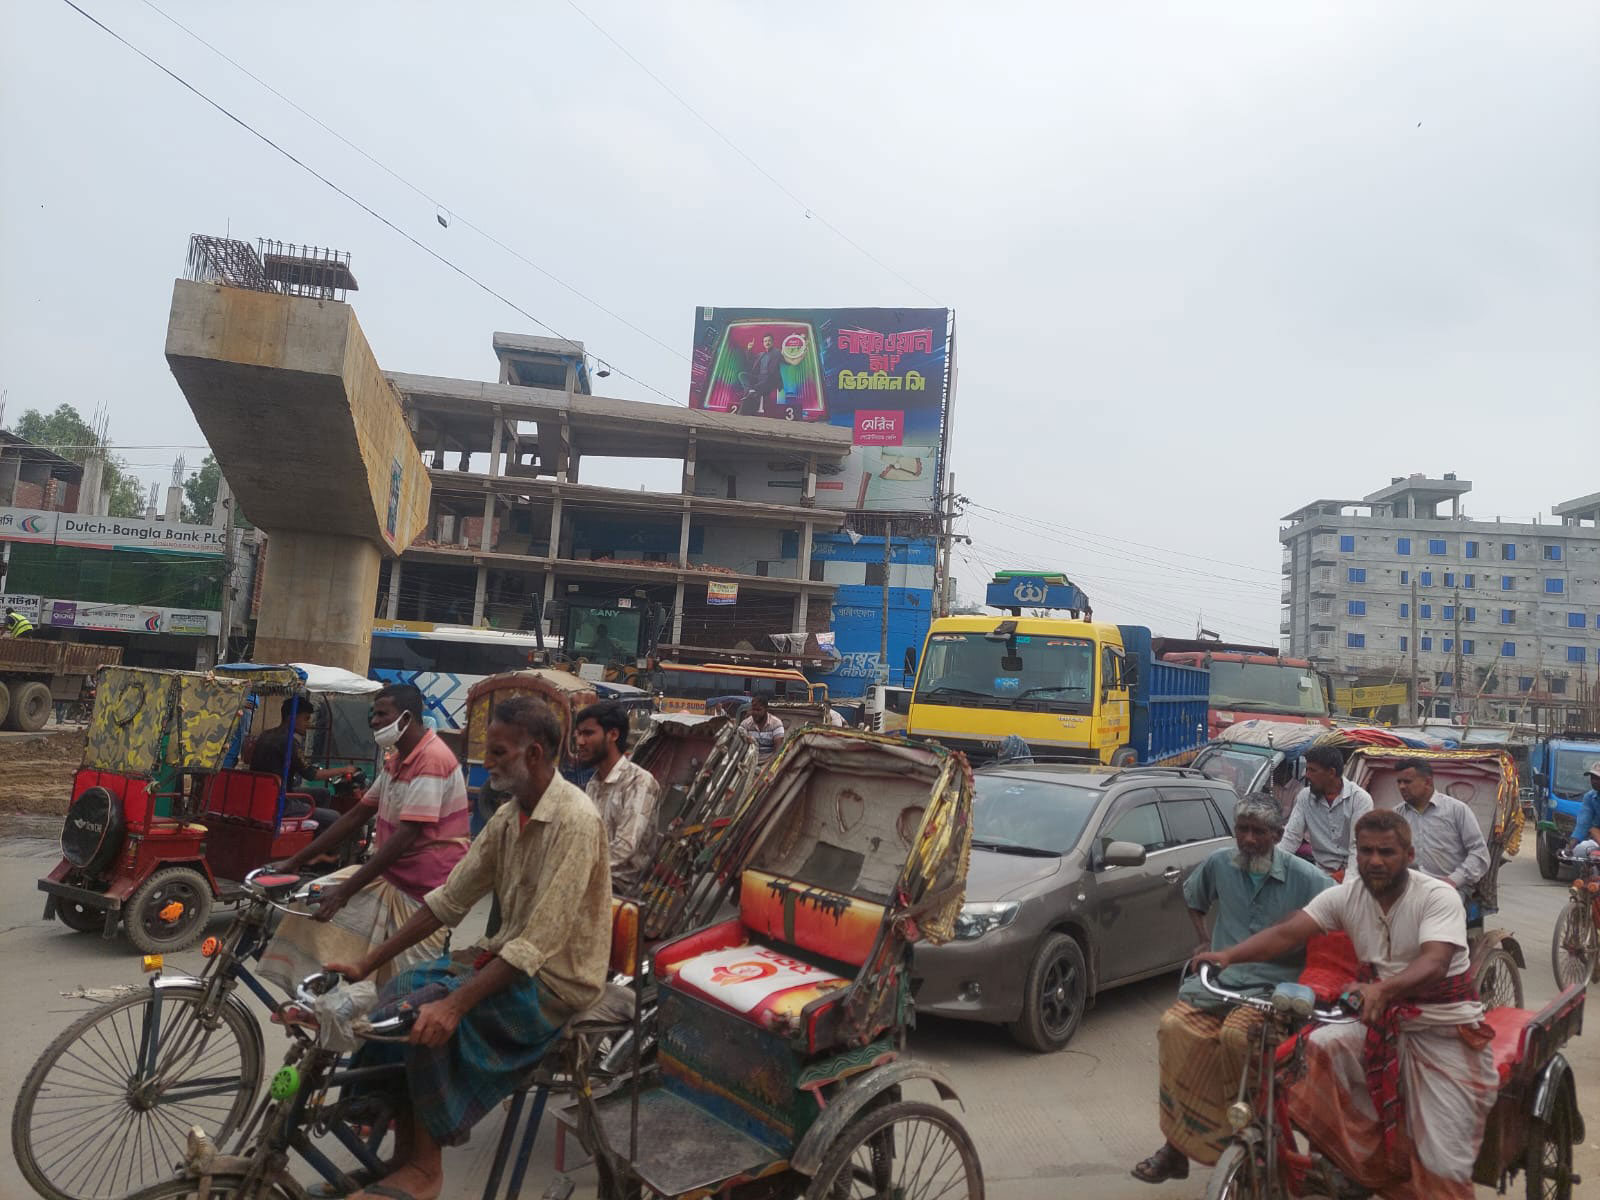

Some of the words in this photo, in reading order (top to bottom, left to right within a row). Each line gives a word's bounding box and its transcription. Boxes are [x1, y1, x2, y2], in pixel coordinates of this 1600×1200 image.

[838, 369, 902, 390] ভিটামিন
[905, 370, 925, 391] সি
[785, 407, 795, 421] 3
[861, 416, 896, 431] মেরিল
[65, 519, 161, 540] Dutch-Bangla
[165, 529, 200, 542] Bank
[981, 740, 1000, 749] TAT
